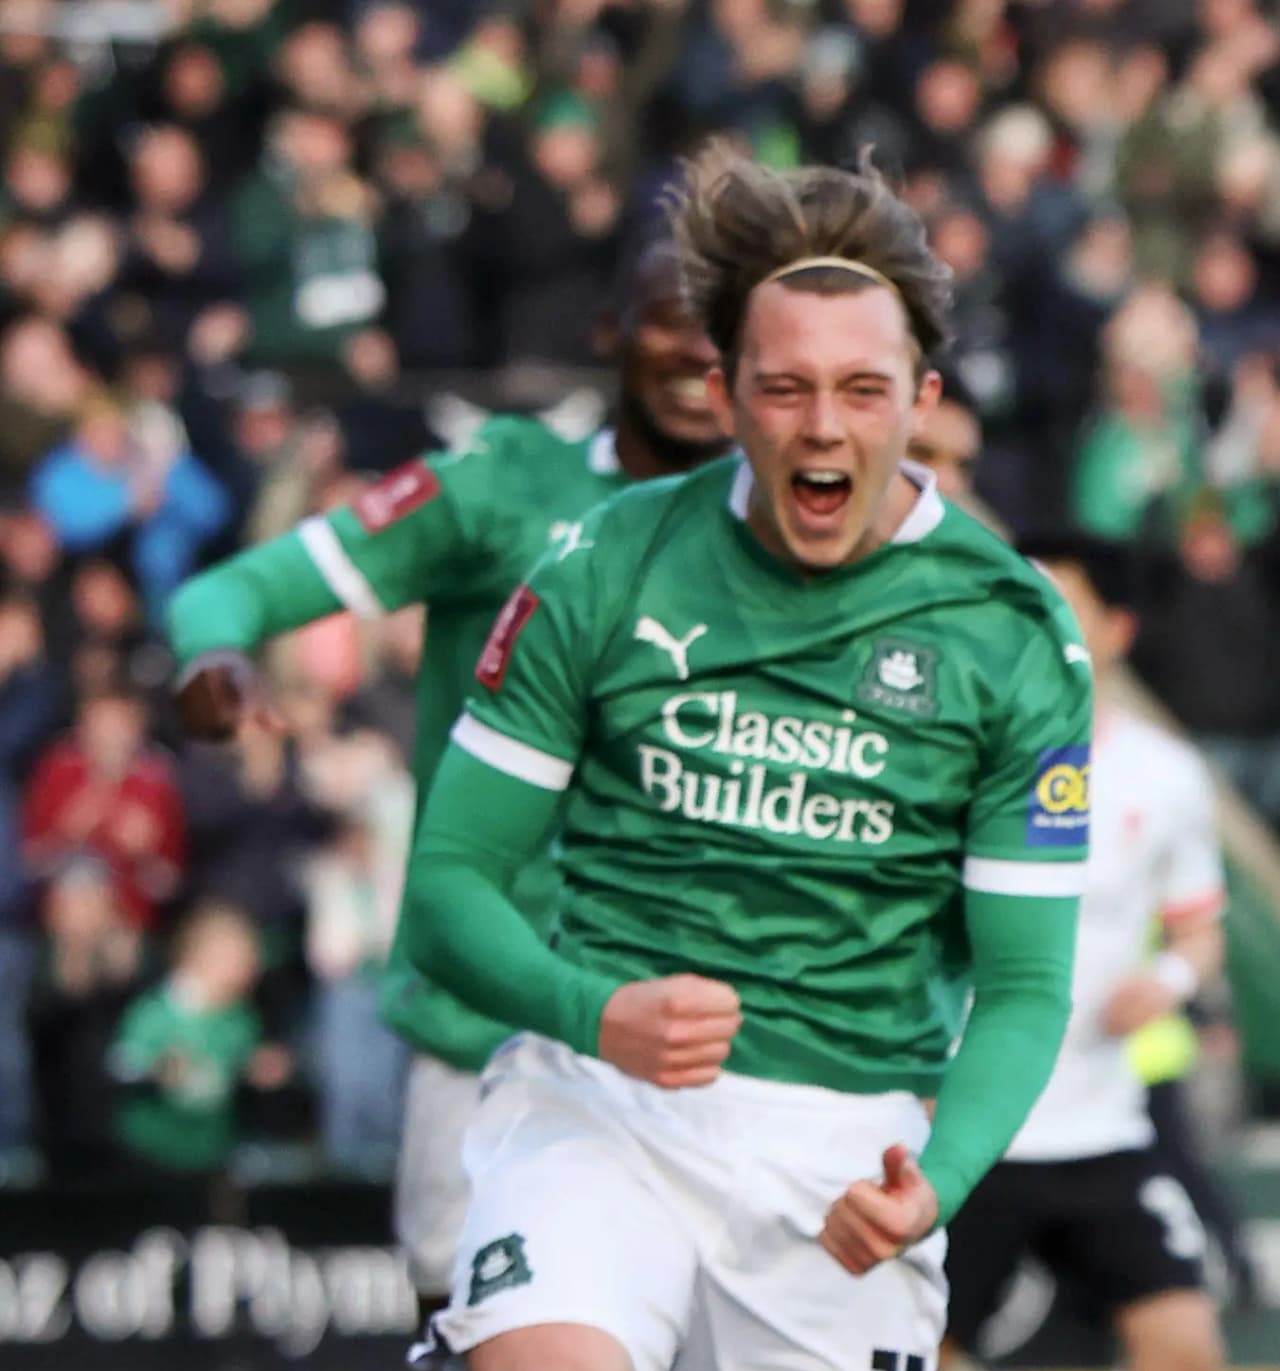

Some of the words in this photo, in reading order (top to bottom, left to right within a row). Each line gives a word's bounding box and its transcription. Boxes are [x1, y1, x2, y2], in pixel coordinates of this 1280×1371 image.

[661, 691, 889, 779] Classic
[638, 744, 895, 845] Builders
[76, 1226, 188, 1342] of
